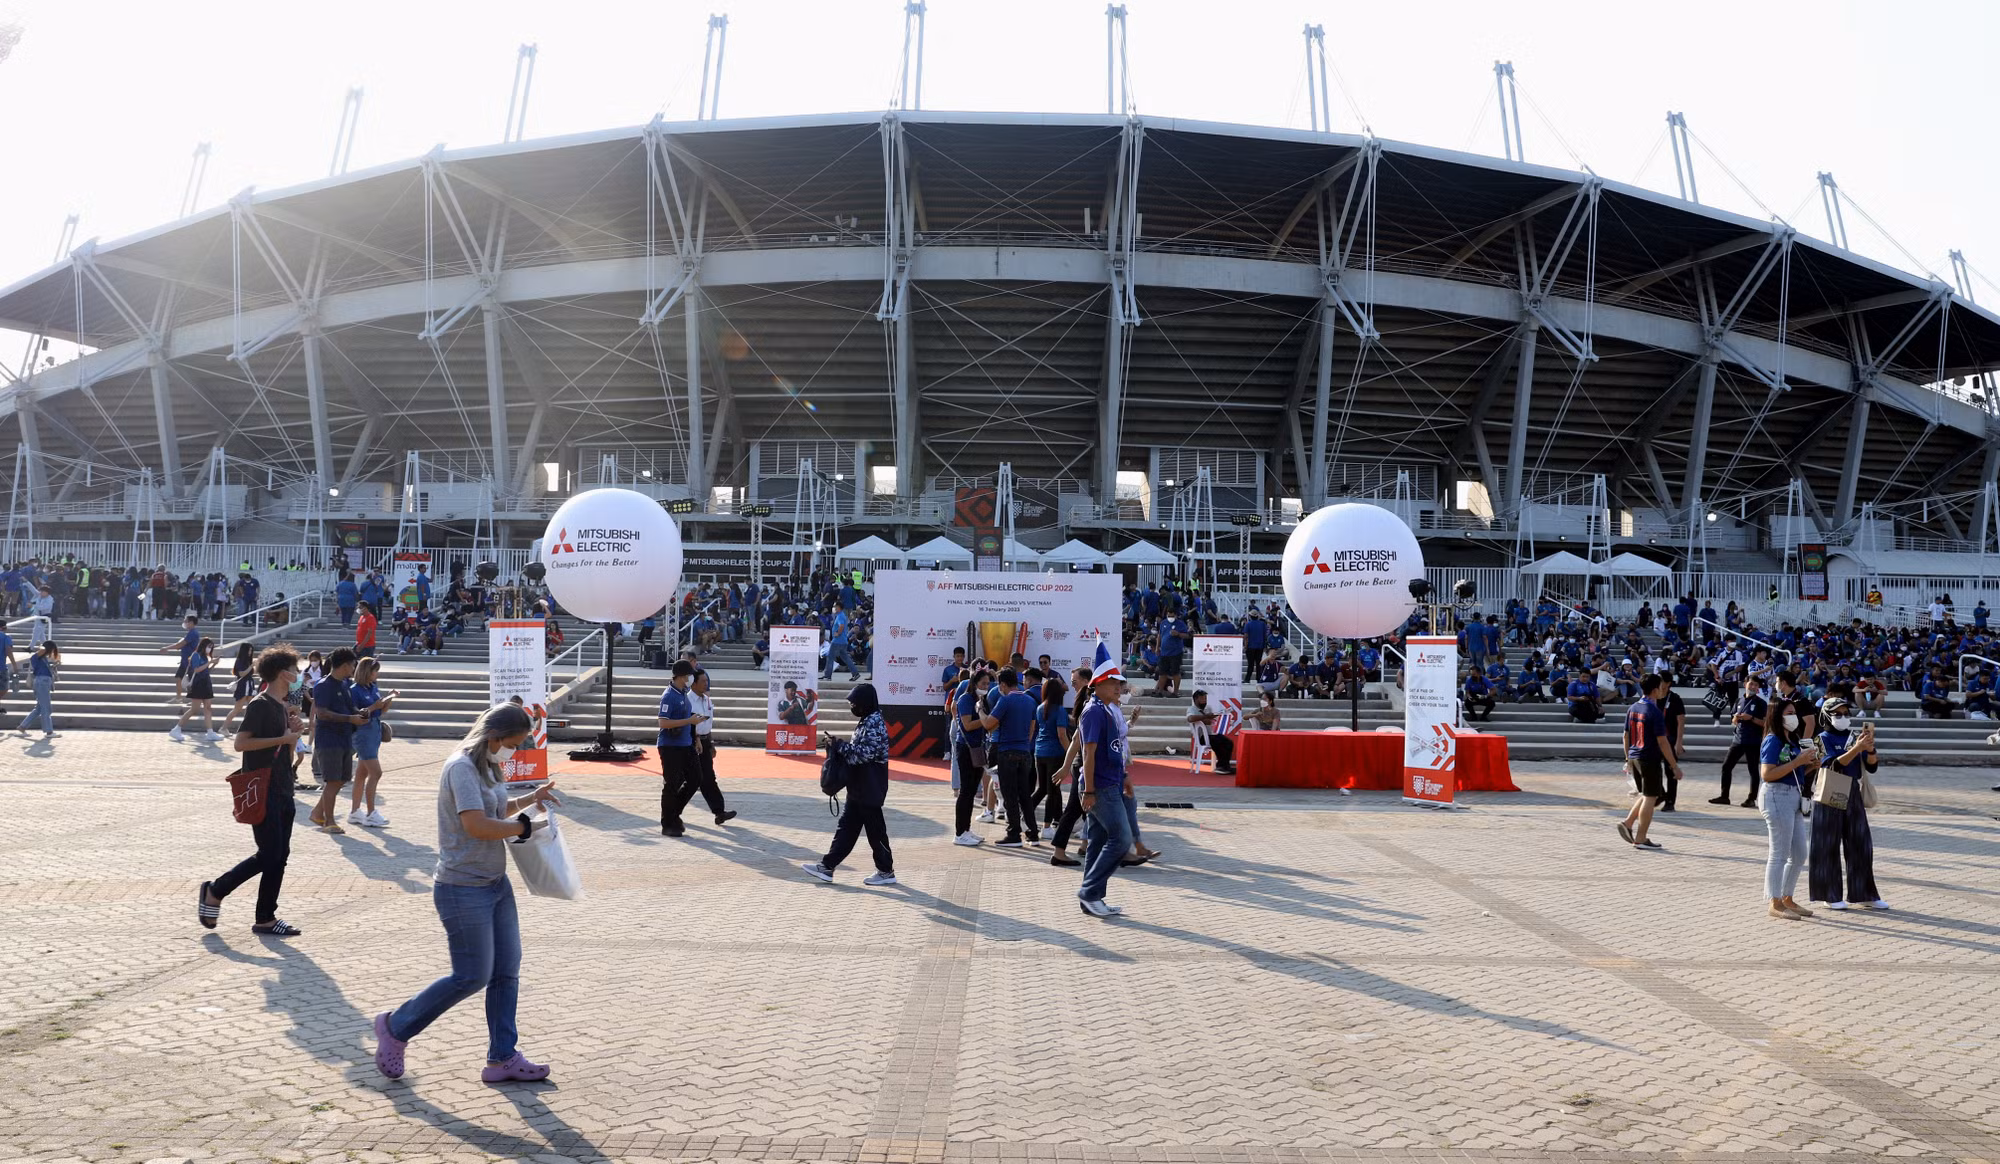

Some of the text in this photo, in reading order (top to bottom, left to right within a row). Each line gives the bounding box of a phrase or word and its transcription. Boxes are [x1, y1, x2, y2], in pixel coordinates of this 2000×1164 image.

[578, 528, 640, 540] MITSUBISHI
[577, 542, 631, 552] ELECTRIC
[1334, 550, 1397, 561] MITSUBISHI
[551, 560, 578, 569] Changes
[612, 558, 639, 566] Better
[690, 558, 730, 566] MITSUBISHI
[1334, 561, 1390, 572] ELECTRIC
[1304, 581, 1336, 590] Changes
[1372, 577, 1397, 586] Better
